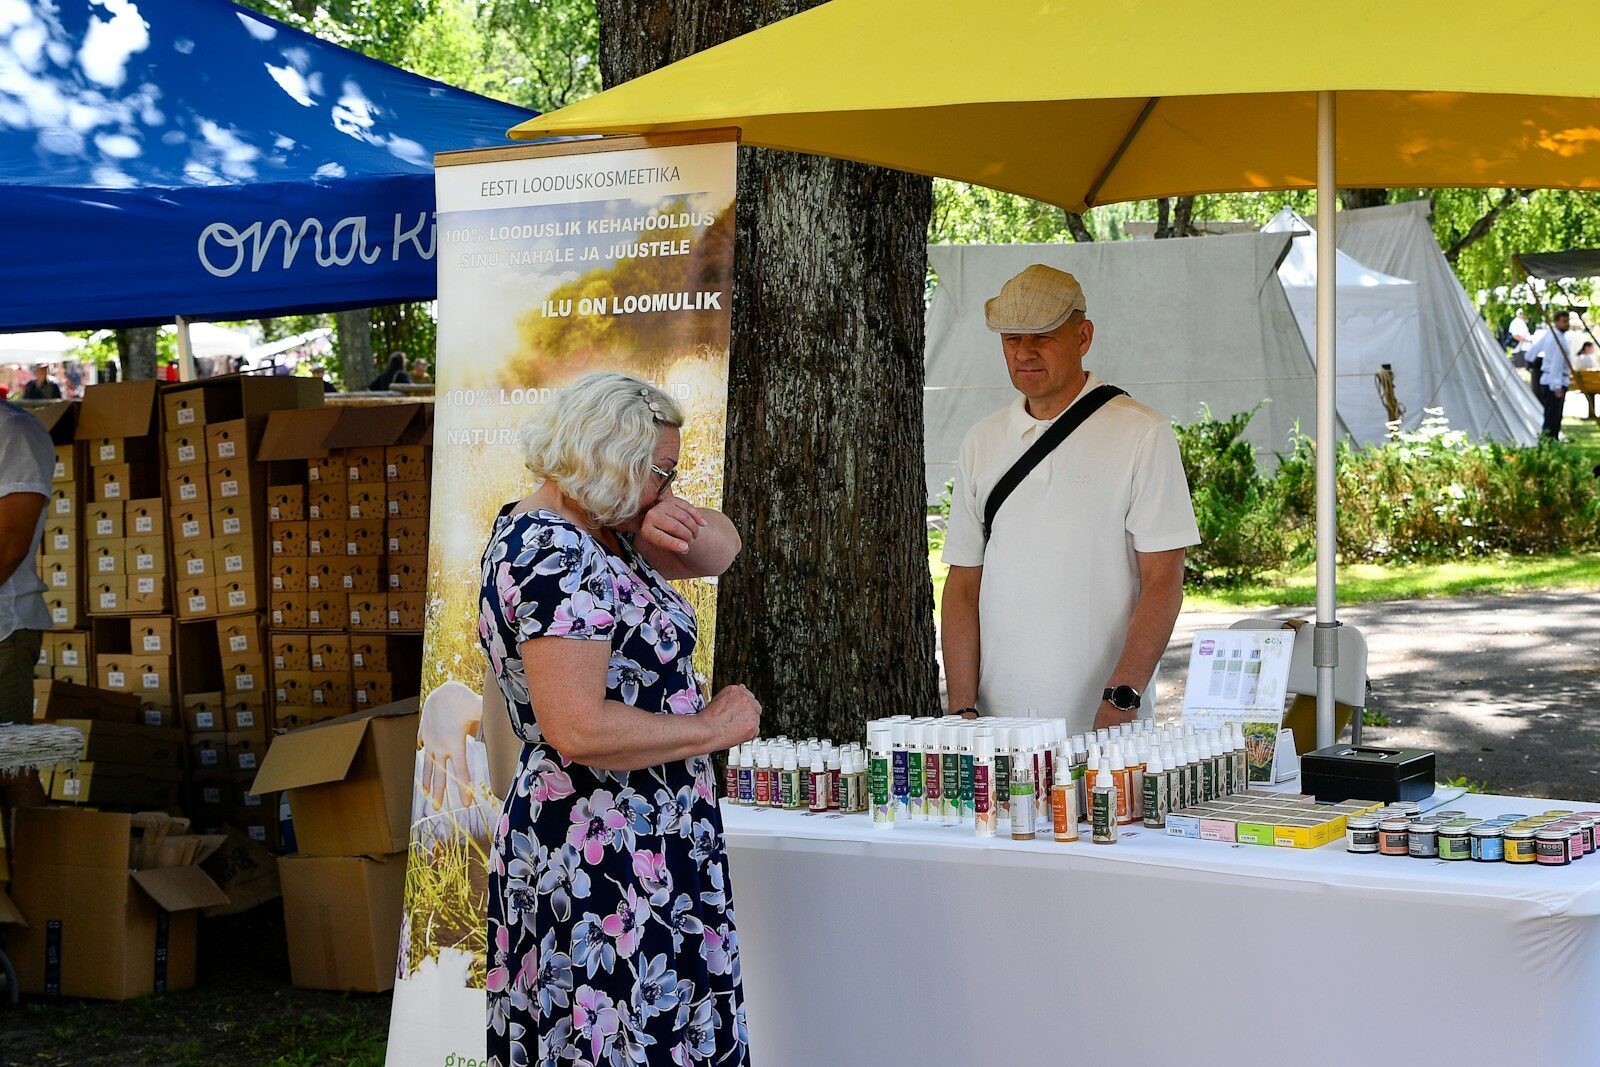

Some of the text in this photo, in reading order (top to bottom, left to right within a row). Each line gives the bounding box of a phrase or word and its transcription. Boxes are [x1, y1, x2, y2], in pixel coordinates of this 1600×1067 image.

[480, 165, 681, 197] EESTI LOODUSKOSMEETIKA
[444, 210, 716, 245] 100% LOODUSLIK KEHAHOOLDUS
[459, 239, 691, 269] SINU NAHALE JA JUUSTELE
[540, 291, 723, 319] ILU ON LOOMULIK
[445, 386, 558, 408] 100% LOOD
[446, 427, 523, 446] NATURA
